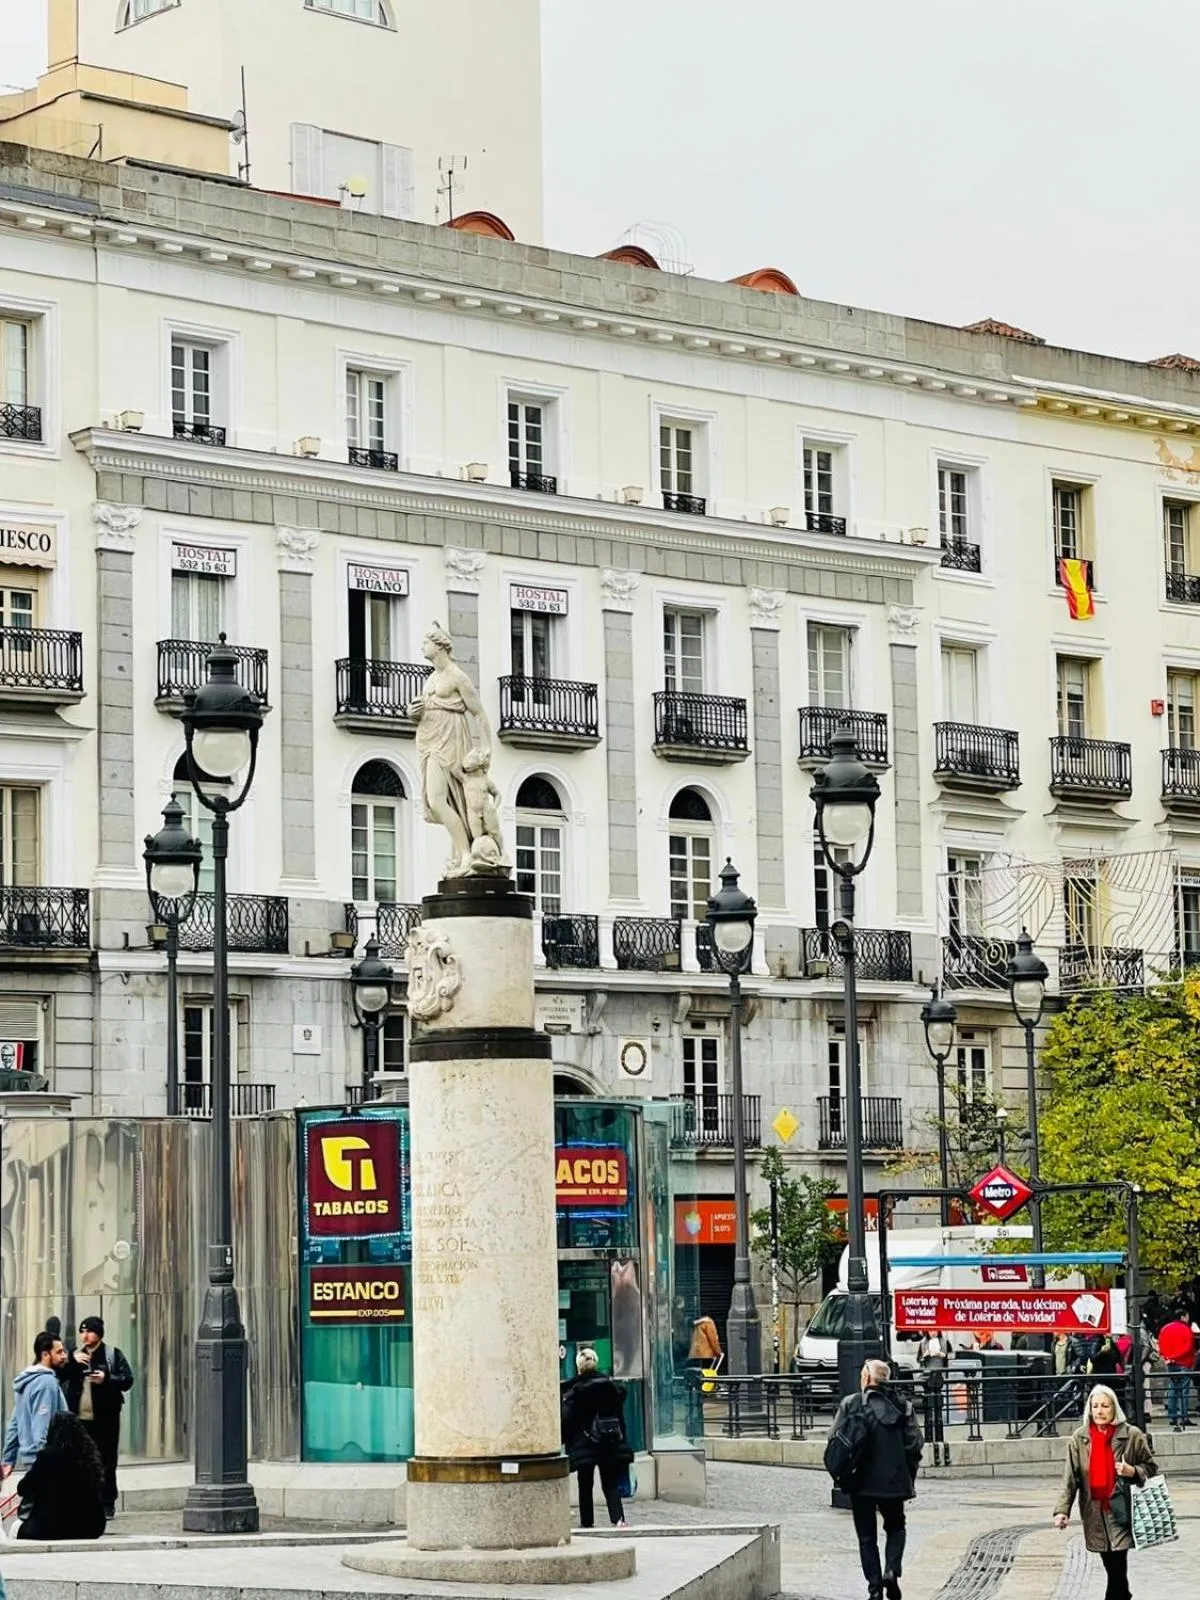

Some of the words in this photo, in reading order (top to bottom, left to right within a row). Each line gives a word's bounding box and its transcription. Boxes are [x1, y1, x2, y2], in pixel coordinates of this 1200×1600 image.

[0, 529, 51, 553] IESCO
[177, 546, 231, 563] HOSTAL
[180, 559, 198, 570] 532
[201, 562, 212, 572] 15
[214, 563, 227, 573] 63
[353, 567, 404, 583] HOSTAL
[356, 578, 402, 593] RUANO
[516, 587, 564, 603] HOSTAL
[518, 599, 535, 610] 532
[537, 601, 547, 611] 15
[555, 1159, 620, 1184] ACOS
[985, 1186, 1012, 1198] Metro
[313, 1199, 389, 1216] TABACOS
[996, 1228, 1010, 1237] Sol
[313, 1281, 400, 1301] ESTANCO
[929, 1296, 939, 1306] de
[943, 1298, 982, 1310] Próxima
[1022, 1299, 1031, 1310] tu
[1033, 1298, 1068, 1310] décimo
[905, 1307, 936, 1317] Navidad
[955, 1310, 966, 1322] de
[1003, 1310, 1014, 1322] de
[1017, 1310, 1056, 1322] Navidad
